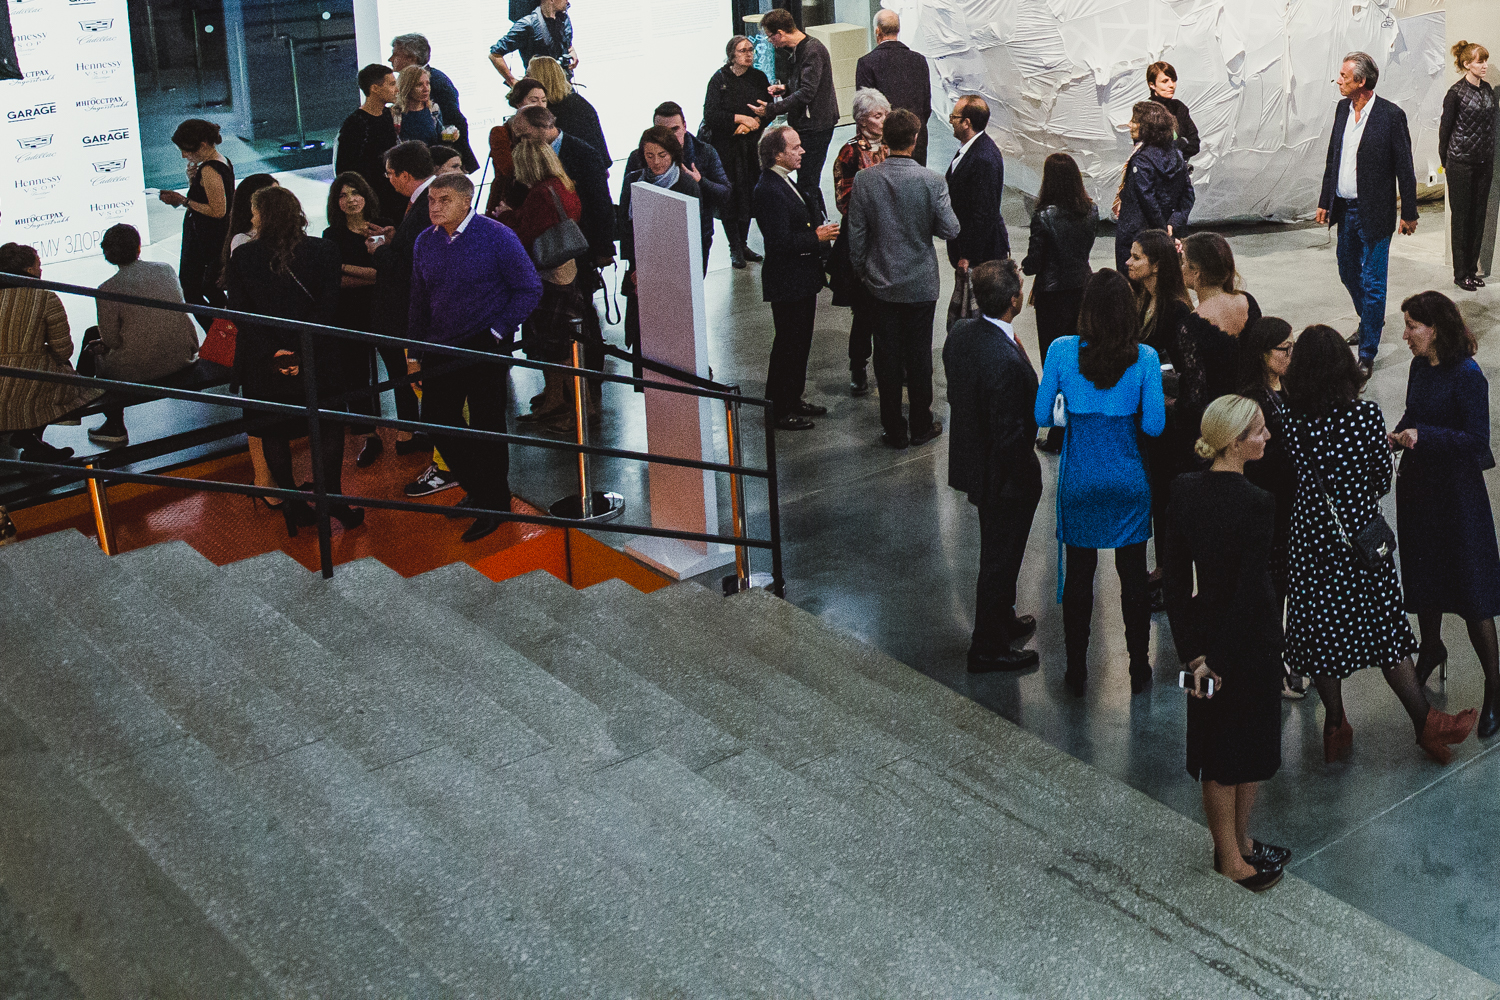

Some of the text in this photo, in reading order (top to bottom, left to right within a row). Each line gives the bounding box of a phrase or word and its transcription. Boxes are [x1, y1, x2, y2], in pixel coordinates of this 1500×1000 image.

[14, 32, 47, 42] nnessy
[76, 60, 122, 71] Hennessy
[75, 96, 123, 107] ИНГОССТРАХ
[7, 105, 57, 119] GARAGE
[82, 131, 130, 144] GARAGE
[14, 175, 62, 188] Hennessy
[90, 200, 135, 212] Hennessy
[15, 212, 64, 225] ИНГОССТРАХ
[29, 238, 60, 258] ЕМУ
